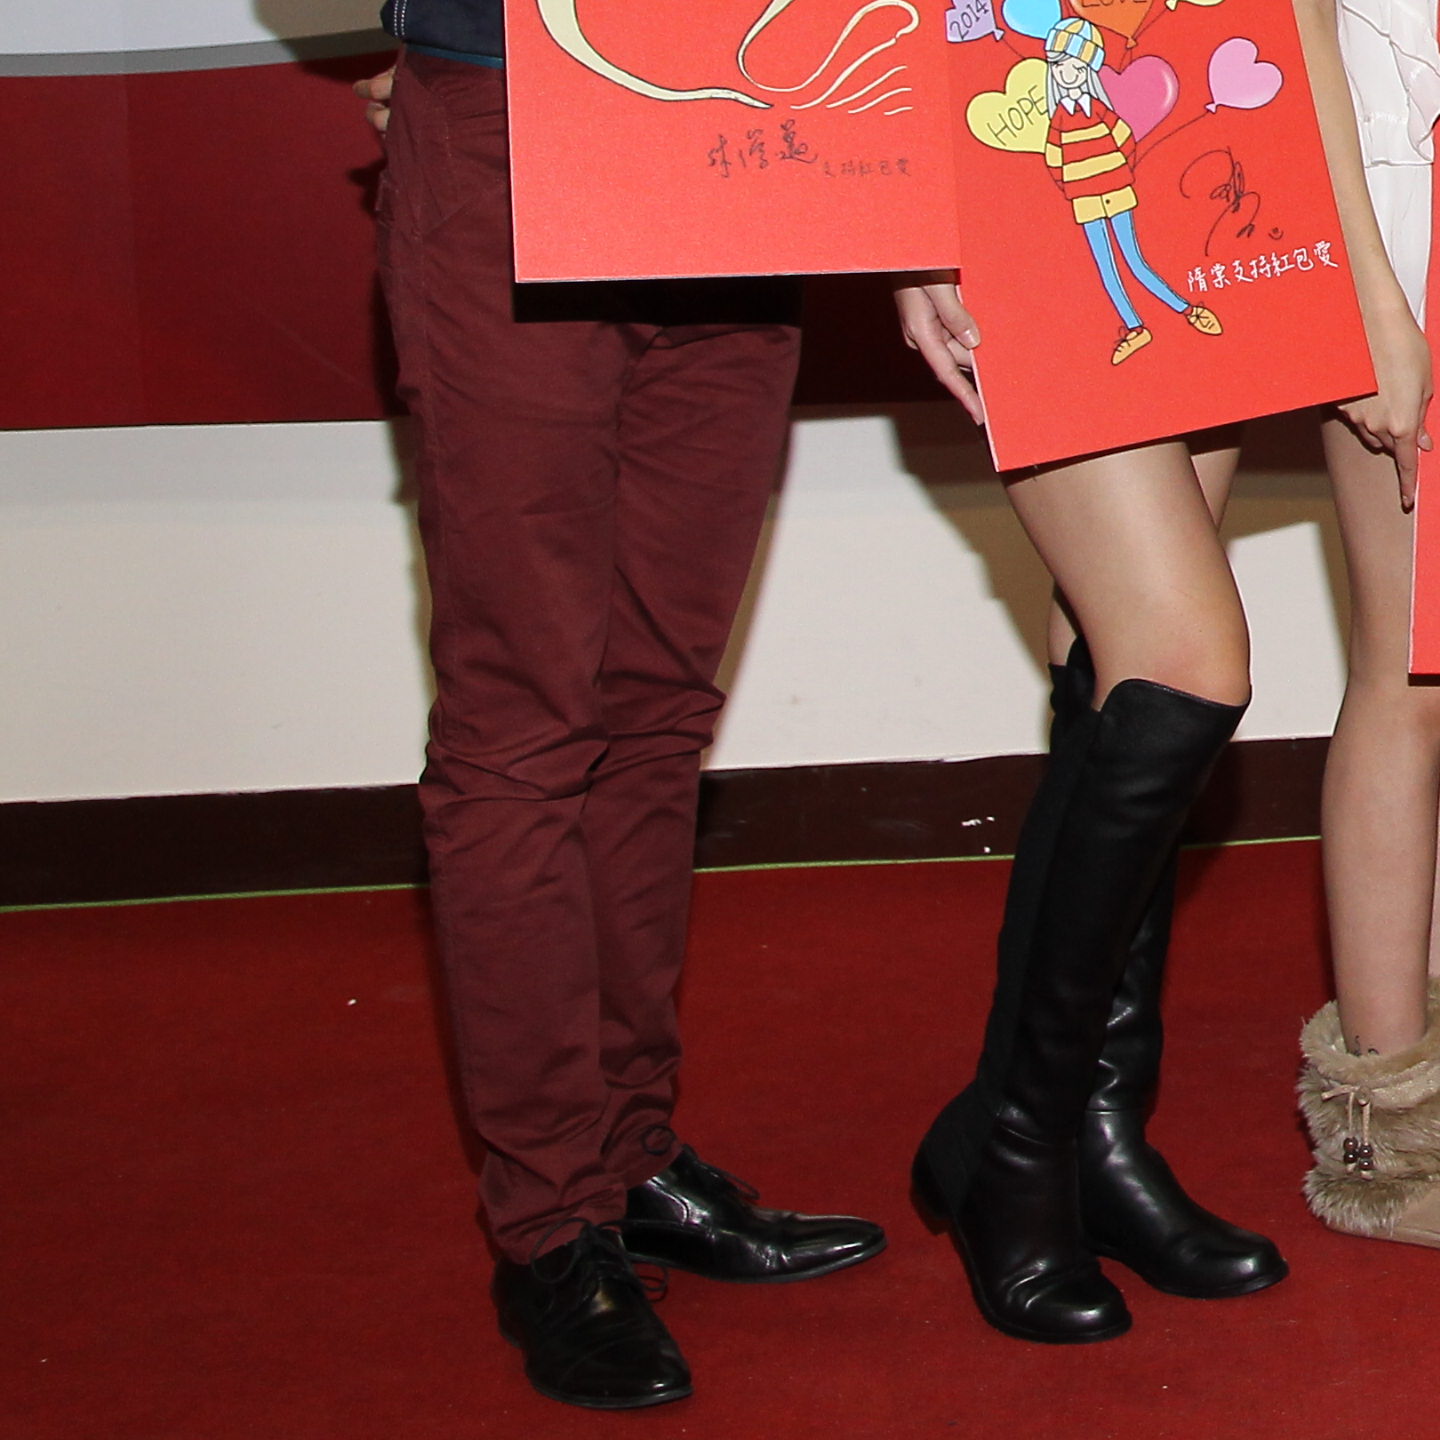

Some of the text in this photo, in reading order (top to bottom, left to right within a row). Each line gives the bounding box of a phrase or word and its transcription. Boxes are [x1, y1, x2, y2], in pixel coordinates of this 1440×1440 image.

[986, 82, 1047, 148] HOPE
[1186, 236, 1339, 294] 隋棠支持紅包愛
